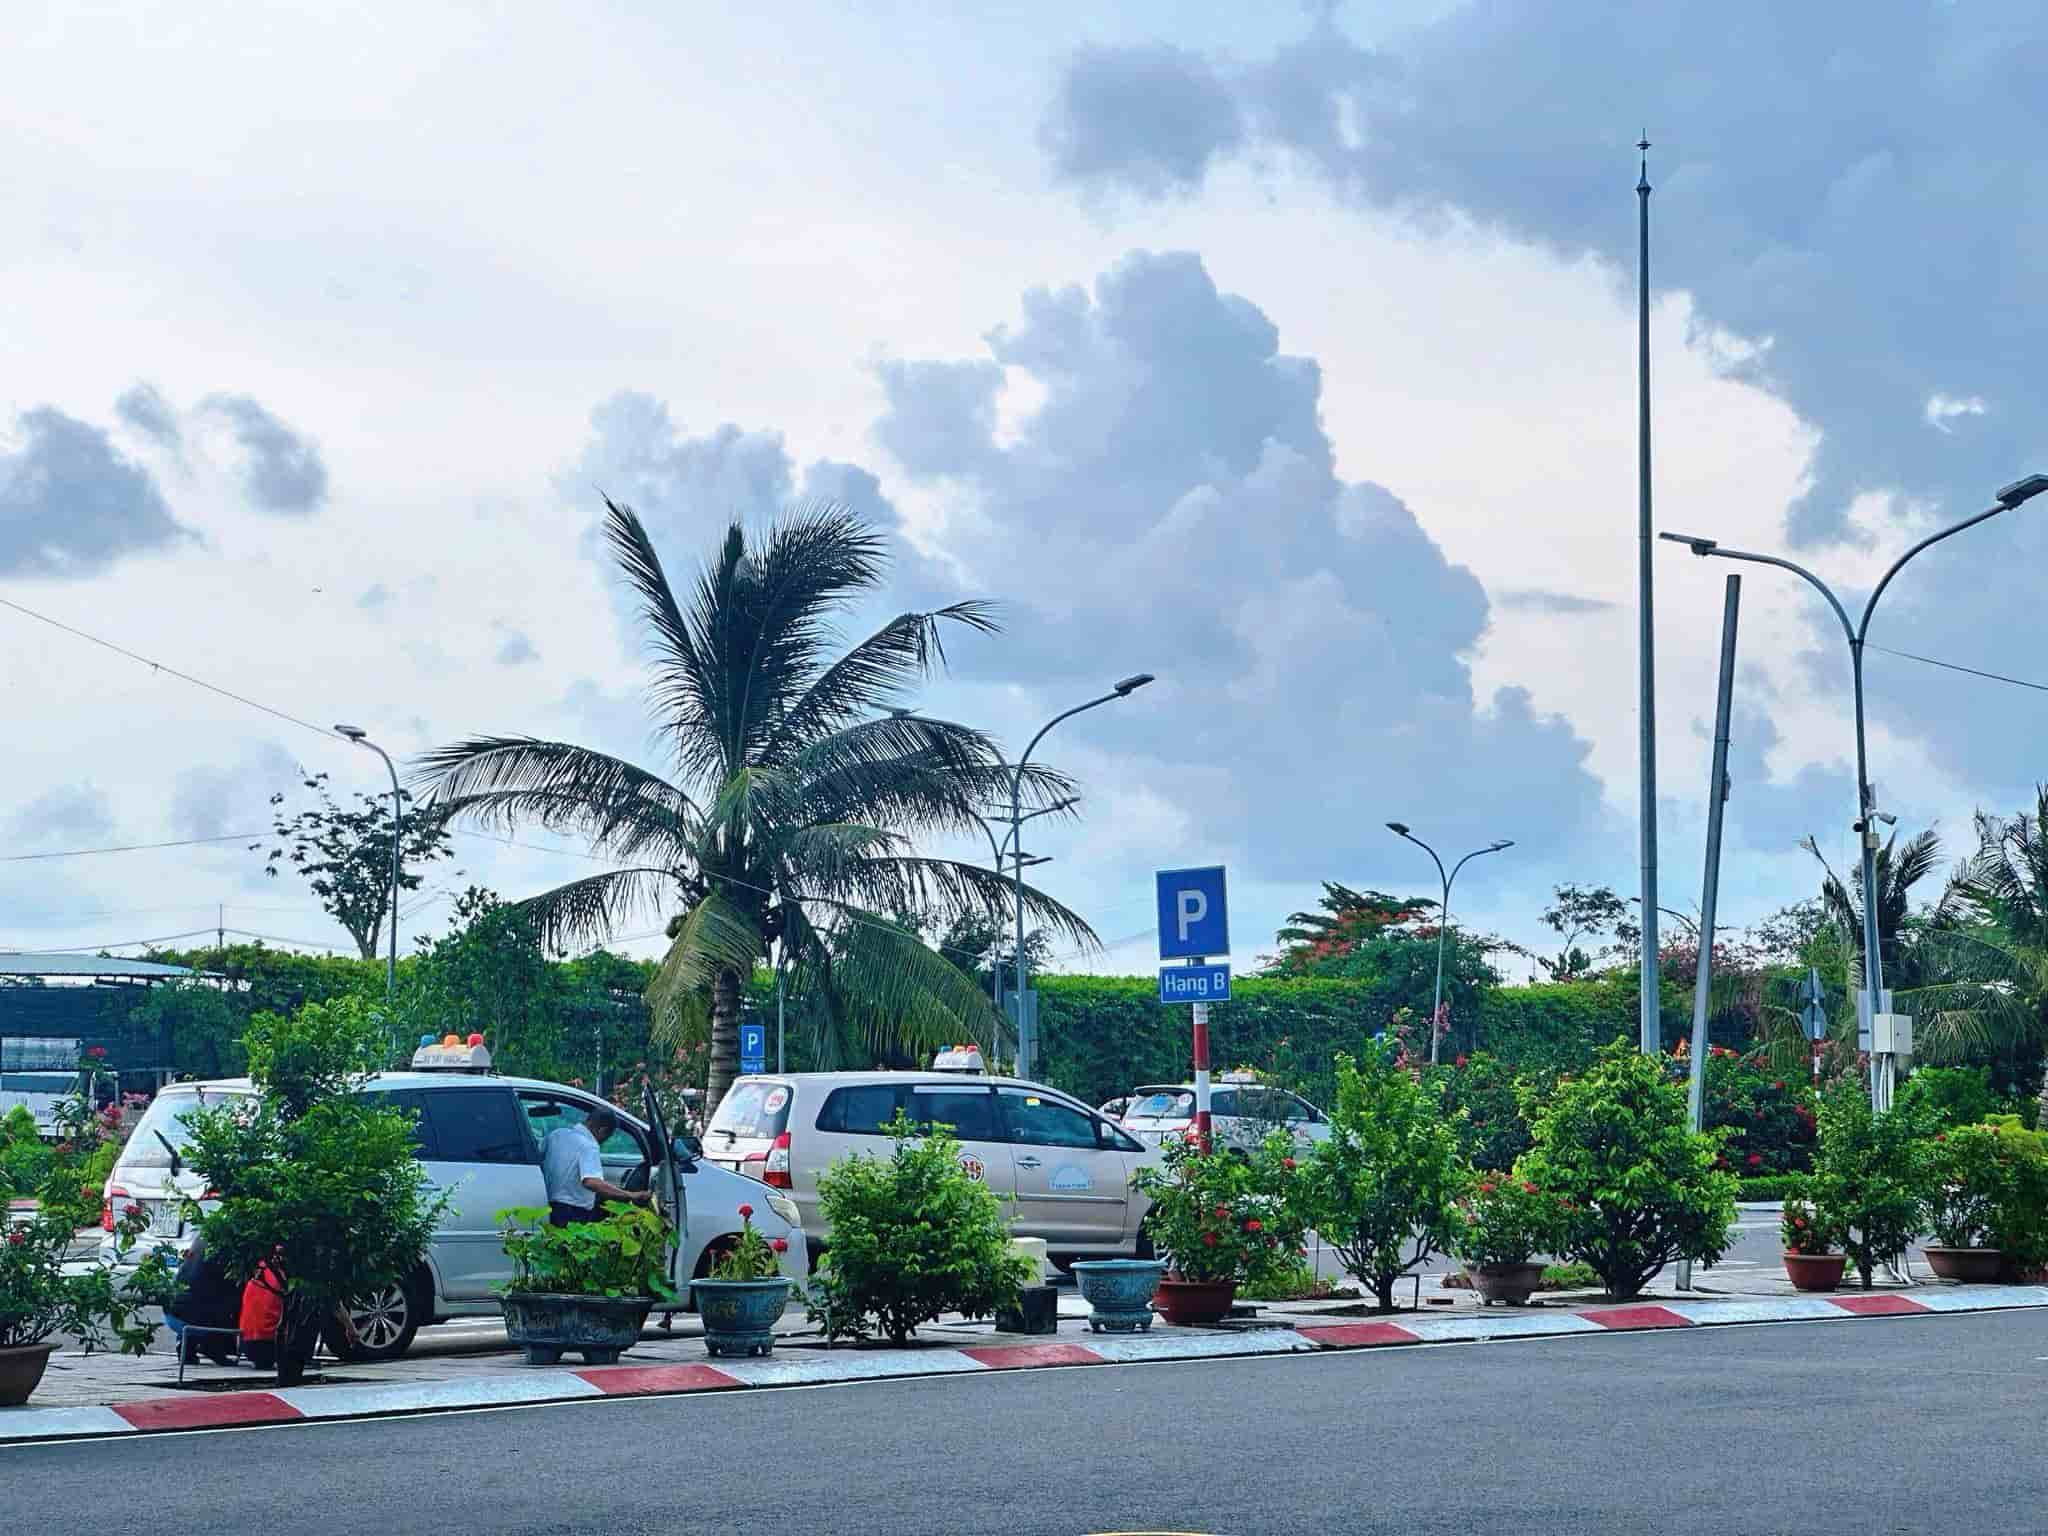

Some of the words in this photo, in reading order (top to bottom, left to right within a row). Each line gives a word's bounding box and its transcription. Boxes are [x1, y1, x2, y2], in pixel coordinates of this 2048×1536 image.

[1177, 889, 1208, 941] P
[1213, 971, 1225, 991] B
[748, 1032, 759, 1052] P
